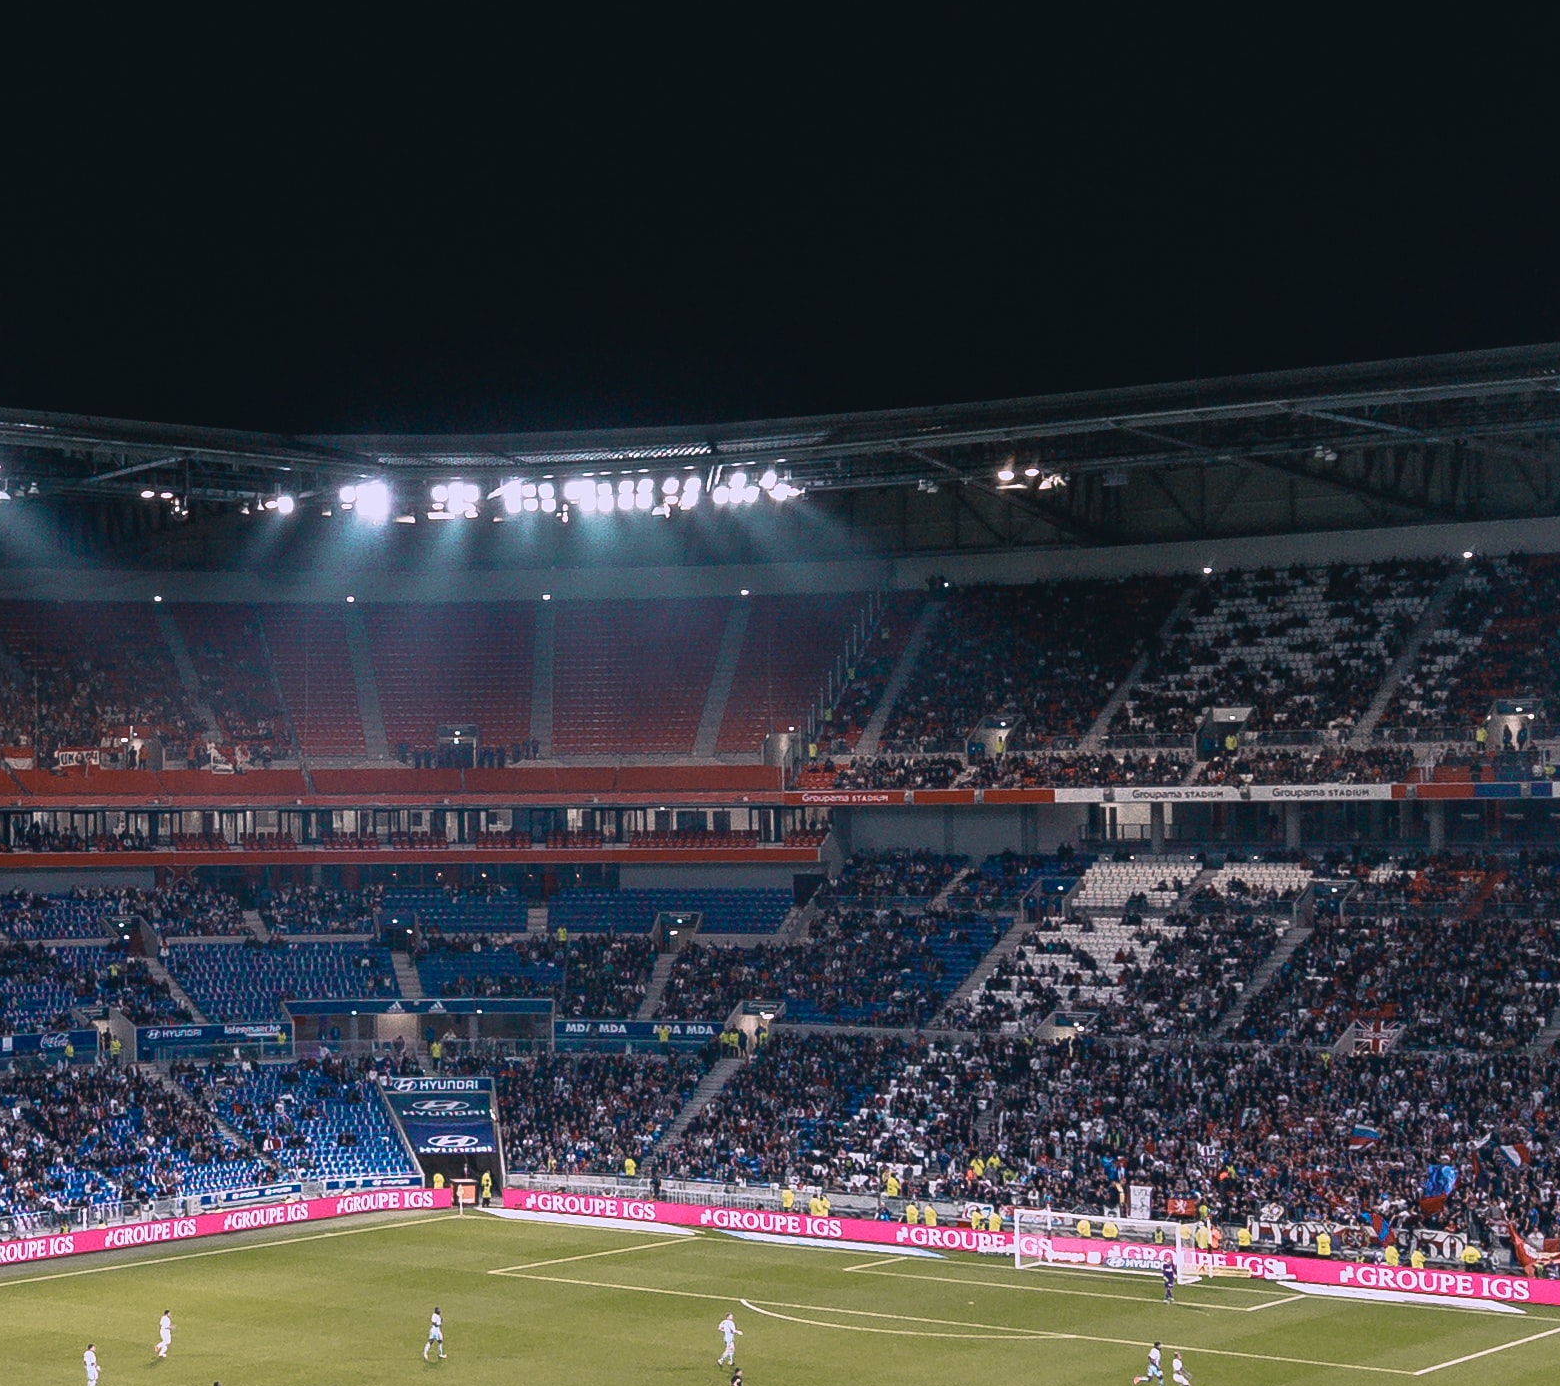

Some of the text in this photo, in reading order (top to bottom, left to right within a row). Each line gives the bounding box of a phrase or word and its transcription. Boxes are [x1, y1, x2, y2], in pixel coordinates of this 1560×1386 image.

[802, 793, 888, 803] Groupama STADIUM
[1132, 789, 1223, 799] Groupama STADIUM
[1272, 787, 1369, 798] Groupama STADIUM
[163, 1028, 201, 1038] HYUNDAI
[600, 1023, 627, 1034] MDA
[686, 1024, 714, 1034] MDA
[420, 1080, 478, 1090] HYUNDAI
[340, 1190, 433, 1213] GROUPE IGS
[538, 1193, 656, 1220] GROUPE IGS
[233, 1203, 308, 1230] GROUPE IGS
[713, 1209, 842, 1237] GROUPE IGS
[112, 1218, 196, 1246] GROUPE IGS
[912, 1226, 1007, 1253] GROUPE
[48, 1235, 75, 1255] IGS
[1356, 1266, 1530, 1301] GROUPE IGS
